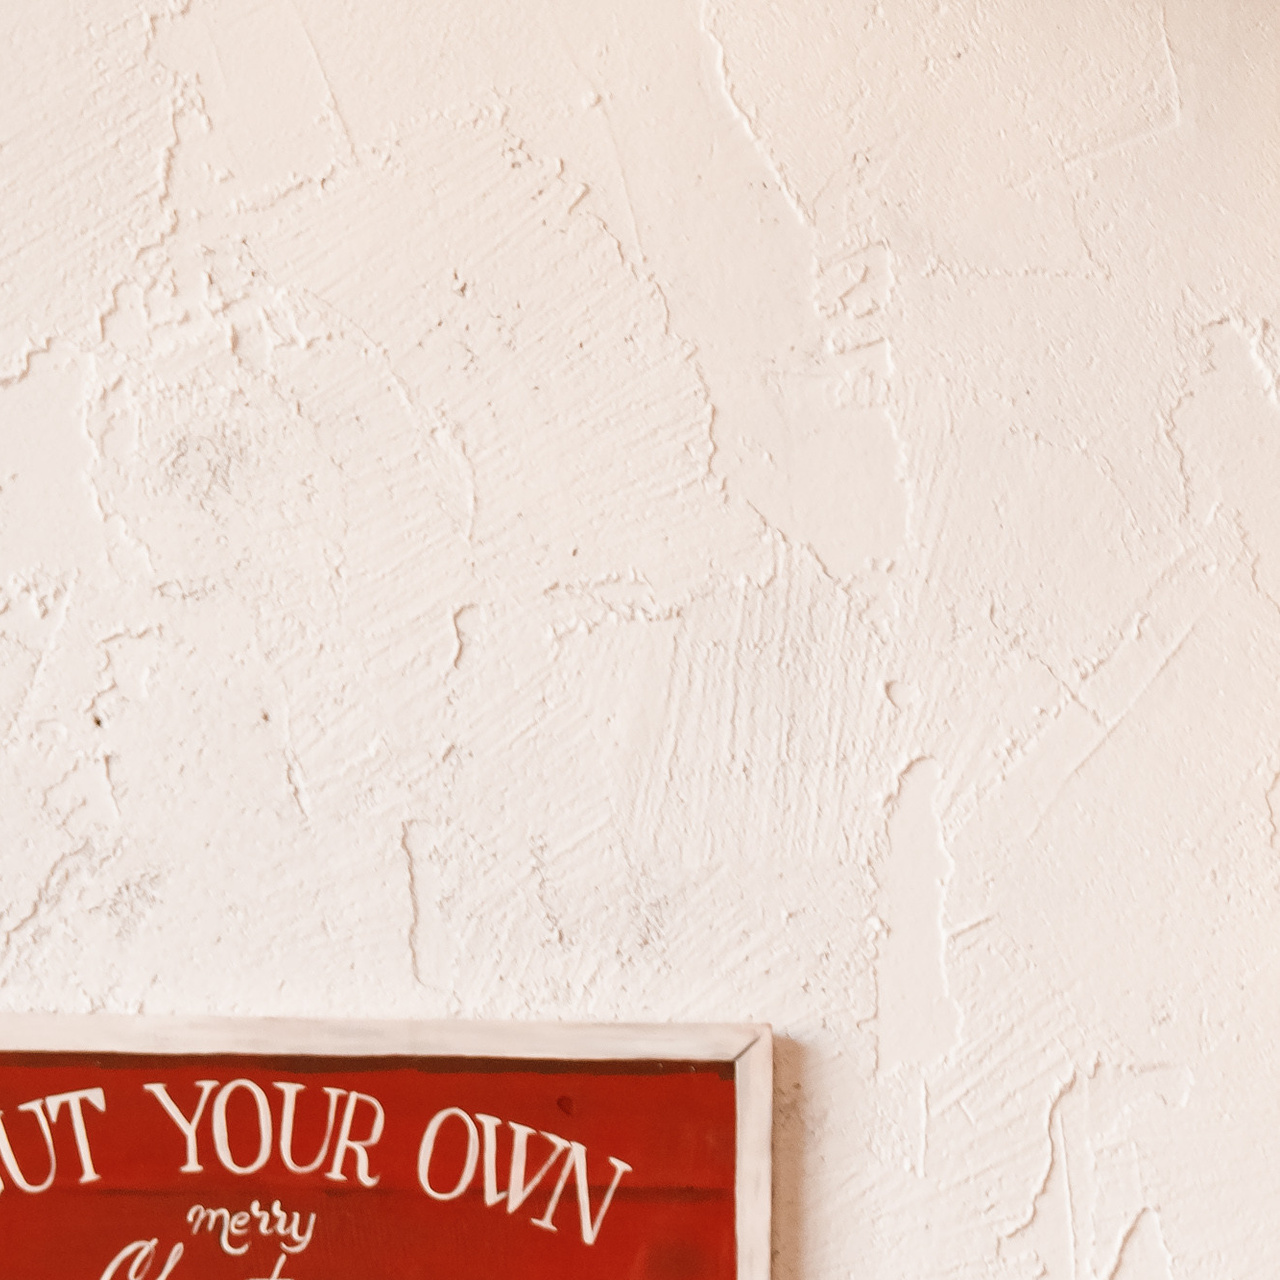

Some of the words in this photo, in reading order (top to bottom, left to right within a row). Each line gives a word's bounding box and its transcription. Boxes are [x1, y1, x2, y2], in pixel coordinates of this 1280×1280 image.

[144, 1078, 385, 1188] YOUR
[417, 1107, 633, 1246] OWN
[186, 1199, 317, 1256] merry
